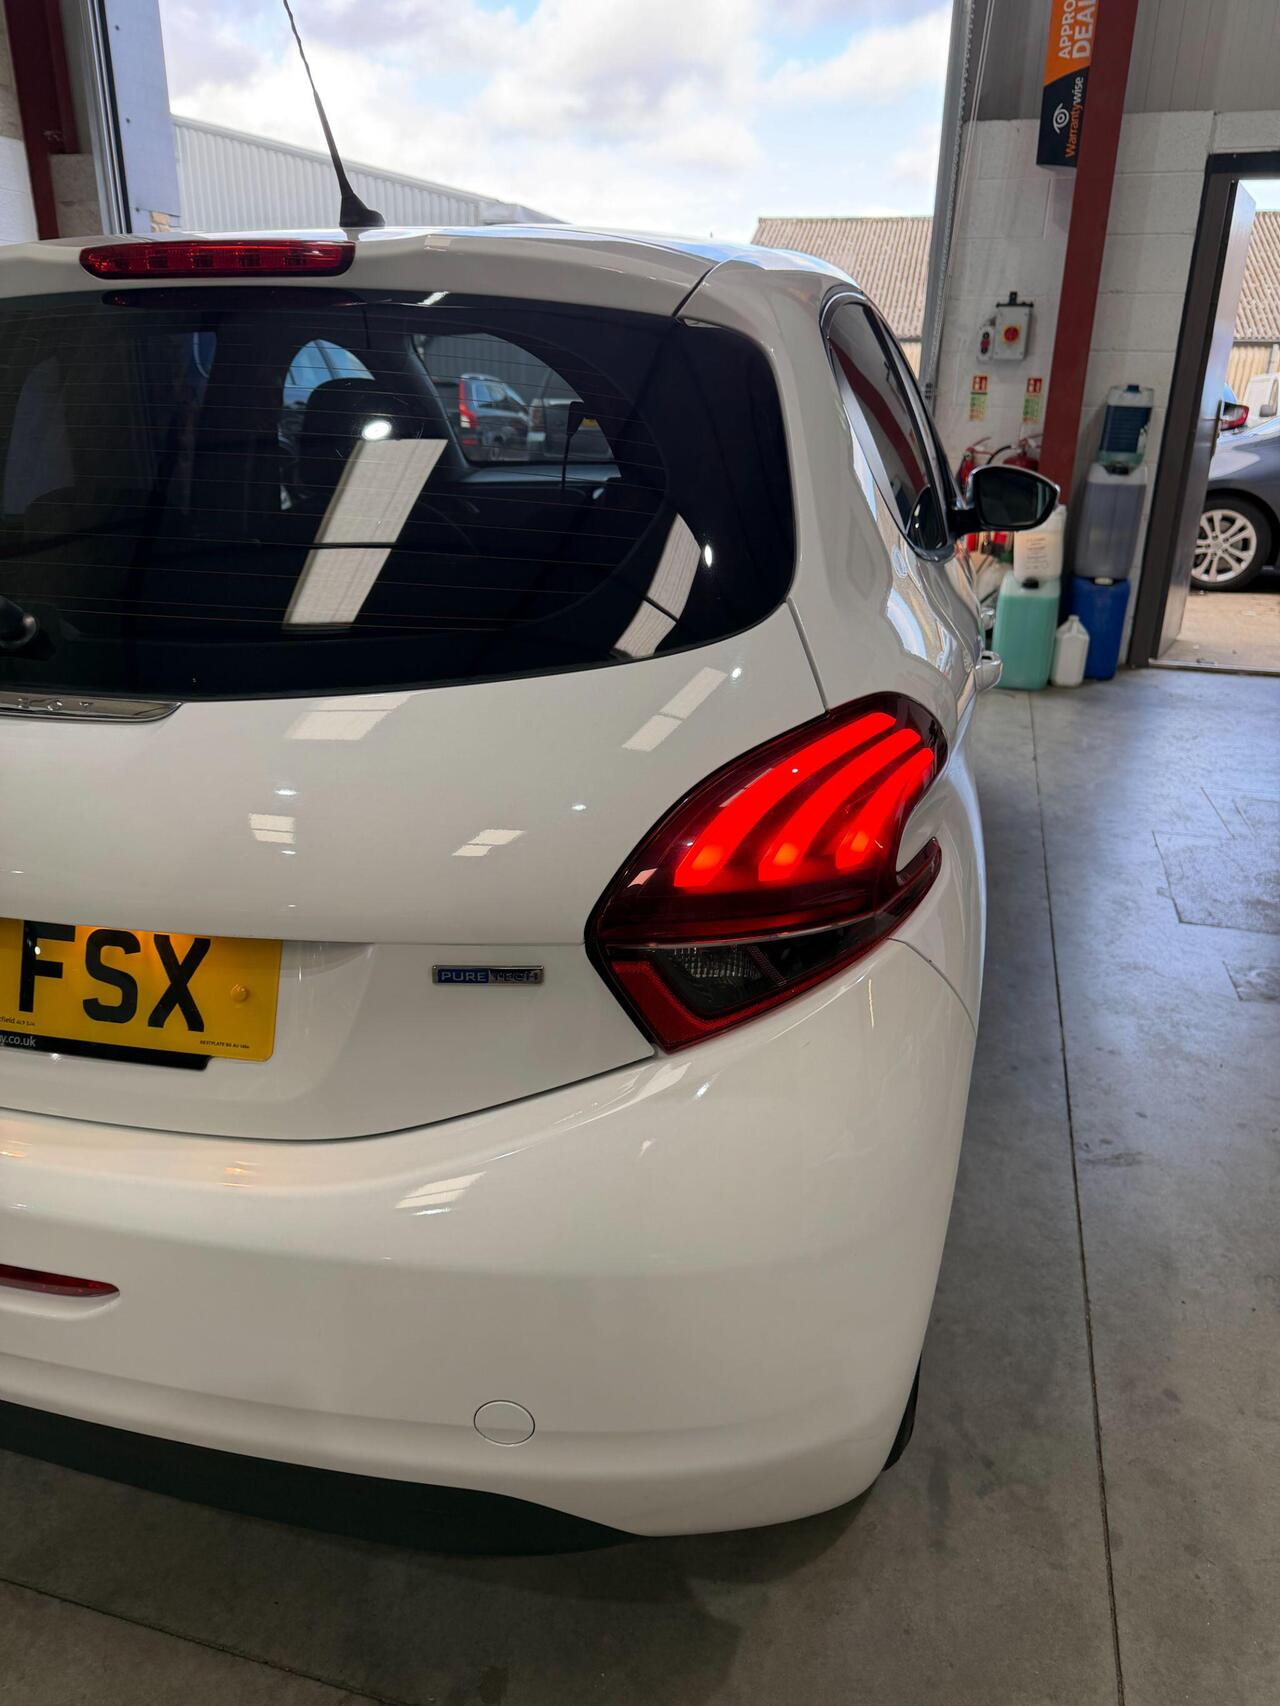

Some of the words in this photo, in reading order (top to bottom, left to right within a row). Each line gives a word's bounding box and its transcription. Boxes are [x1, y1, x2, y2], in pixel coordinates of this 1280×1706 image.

[1064, 76, 1084, 158] Warrantywise
[18, 920, 212, 1032] FSX
[441, 971, 487, 981] PURE
